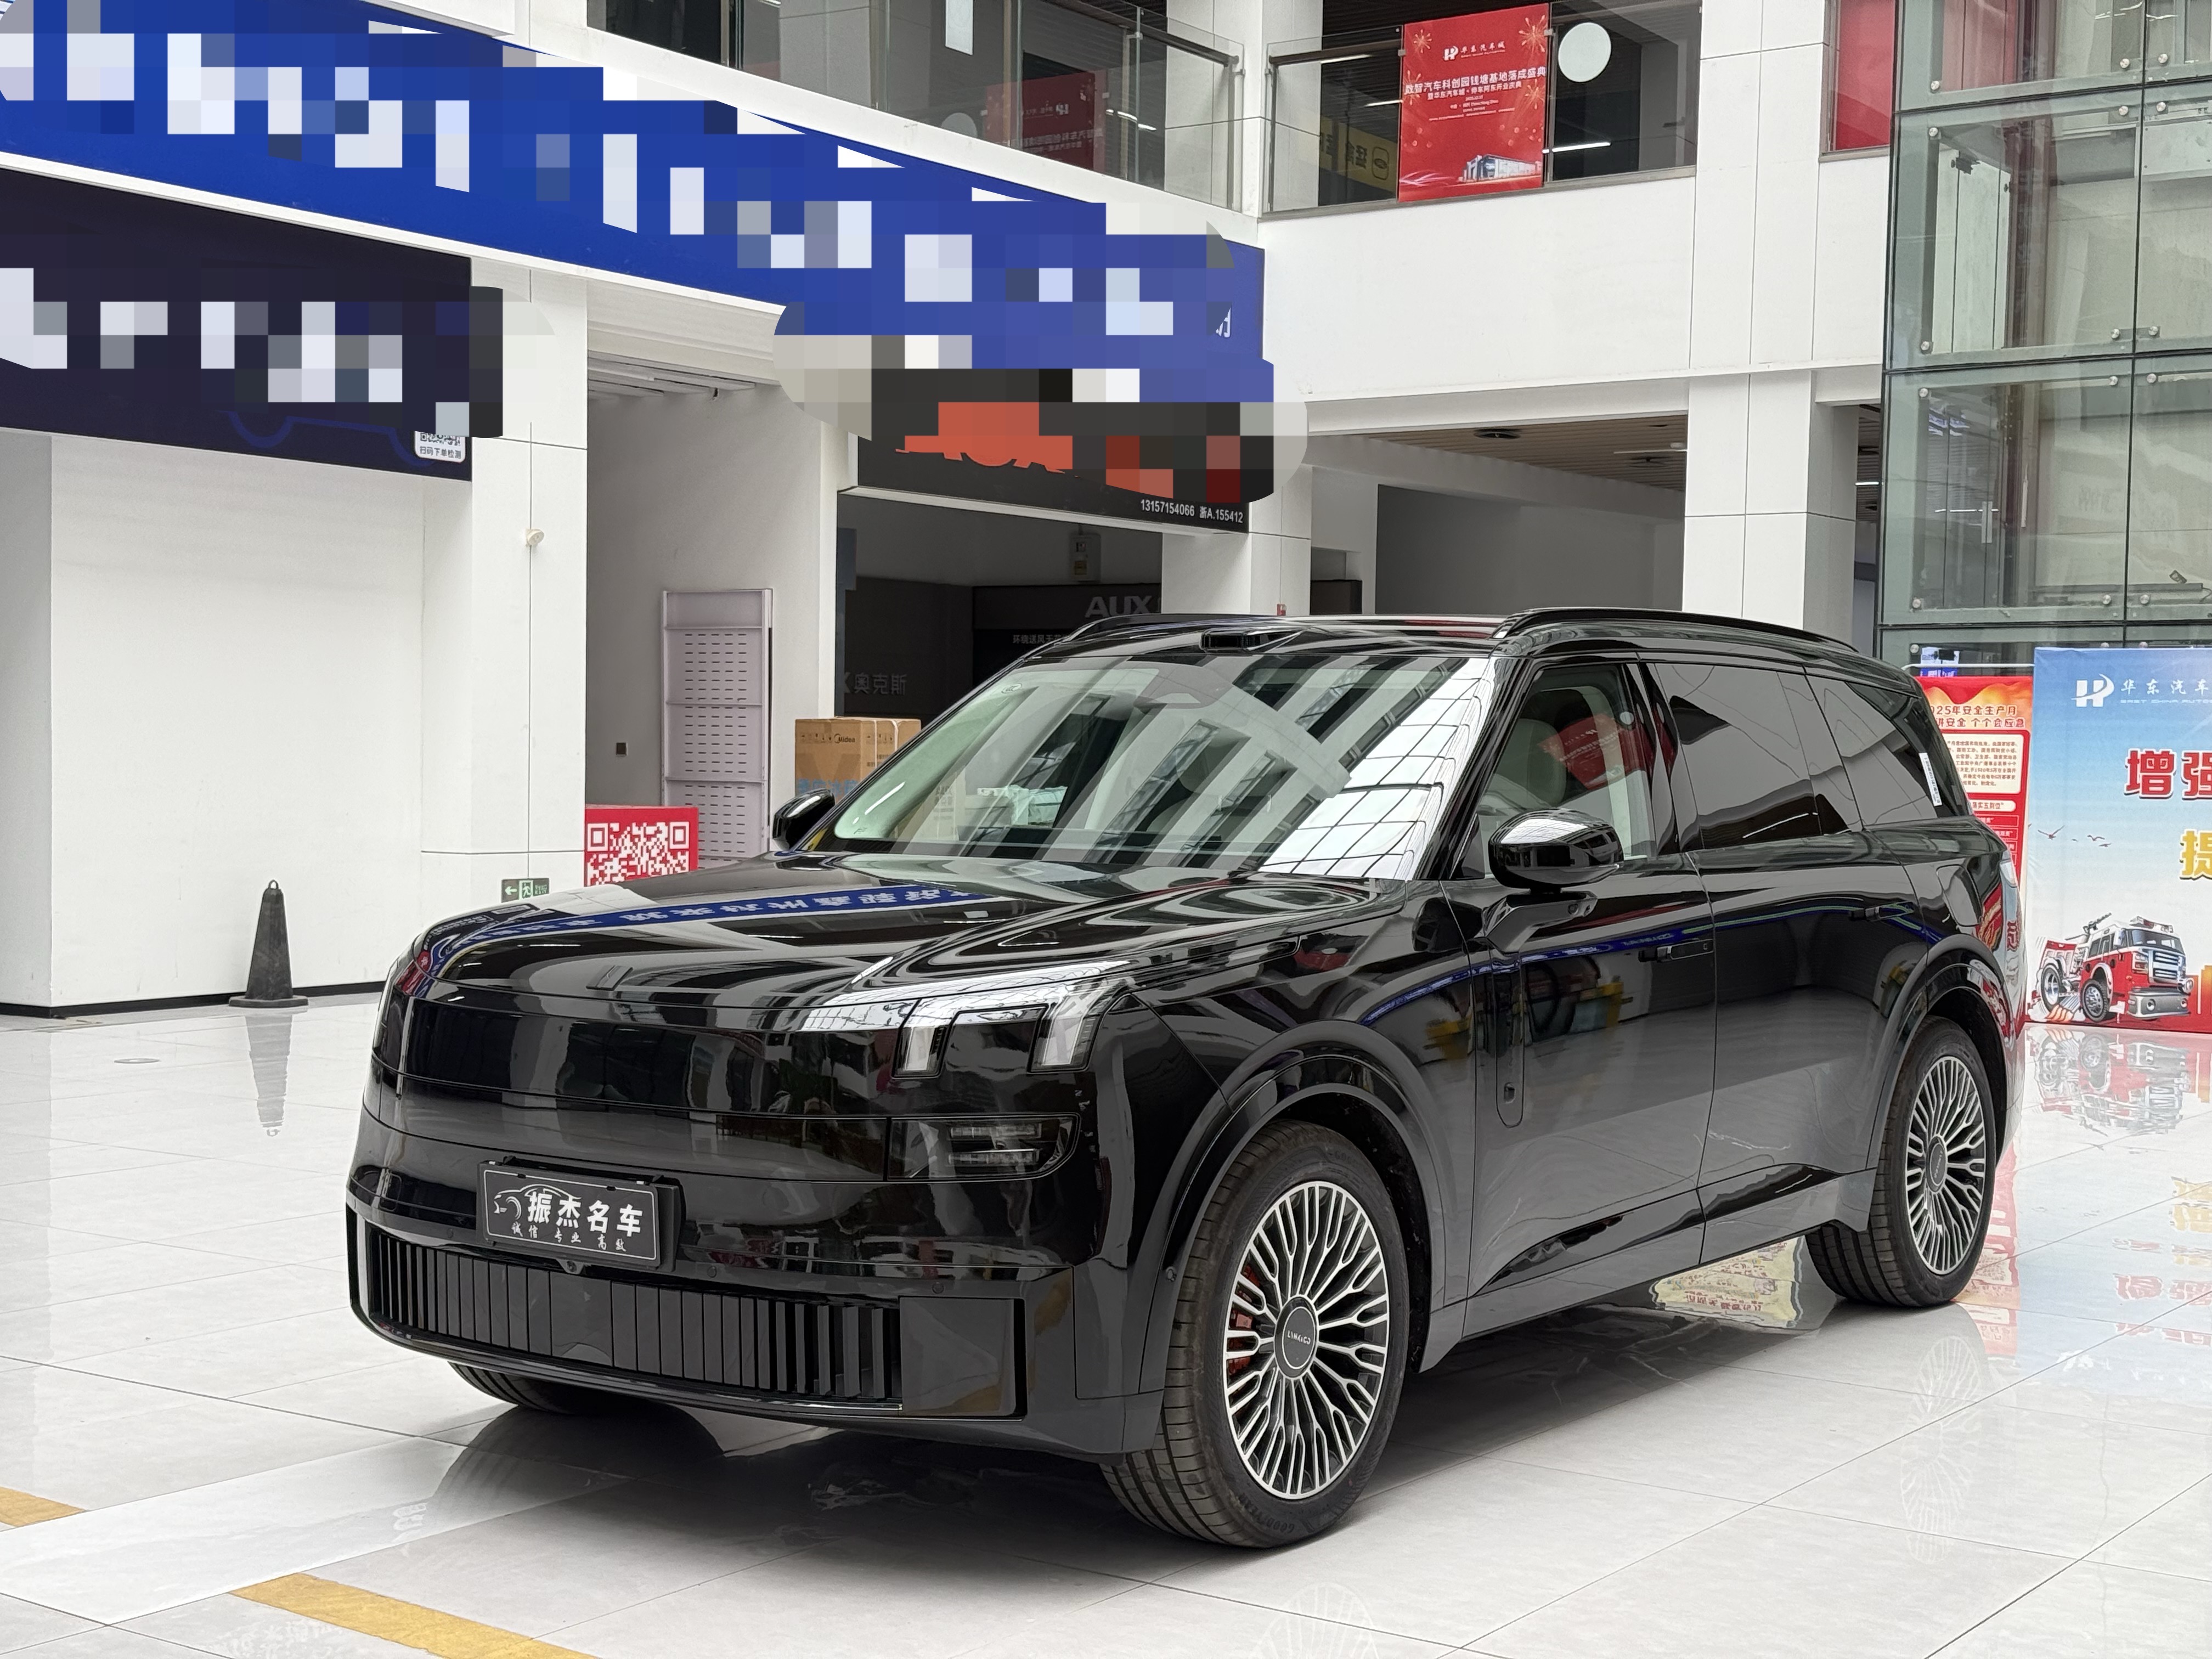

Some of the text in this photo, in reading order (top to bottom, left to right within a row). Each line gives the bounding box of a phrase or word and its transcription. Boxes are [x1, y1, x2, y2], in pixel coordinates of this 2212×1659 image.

[1141, 499, 1243, 523] 13157154066 浙A.155412
[1085, 595, 1152, 618] AUX
[836, 734, 855, 743] Midea
[527, 1192, 643, 1237] 振杰名车
